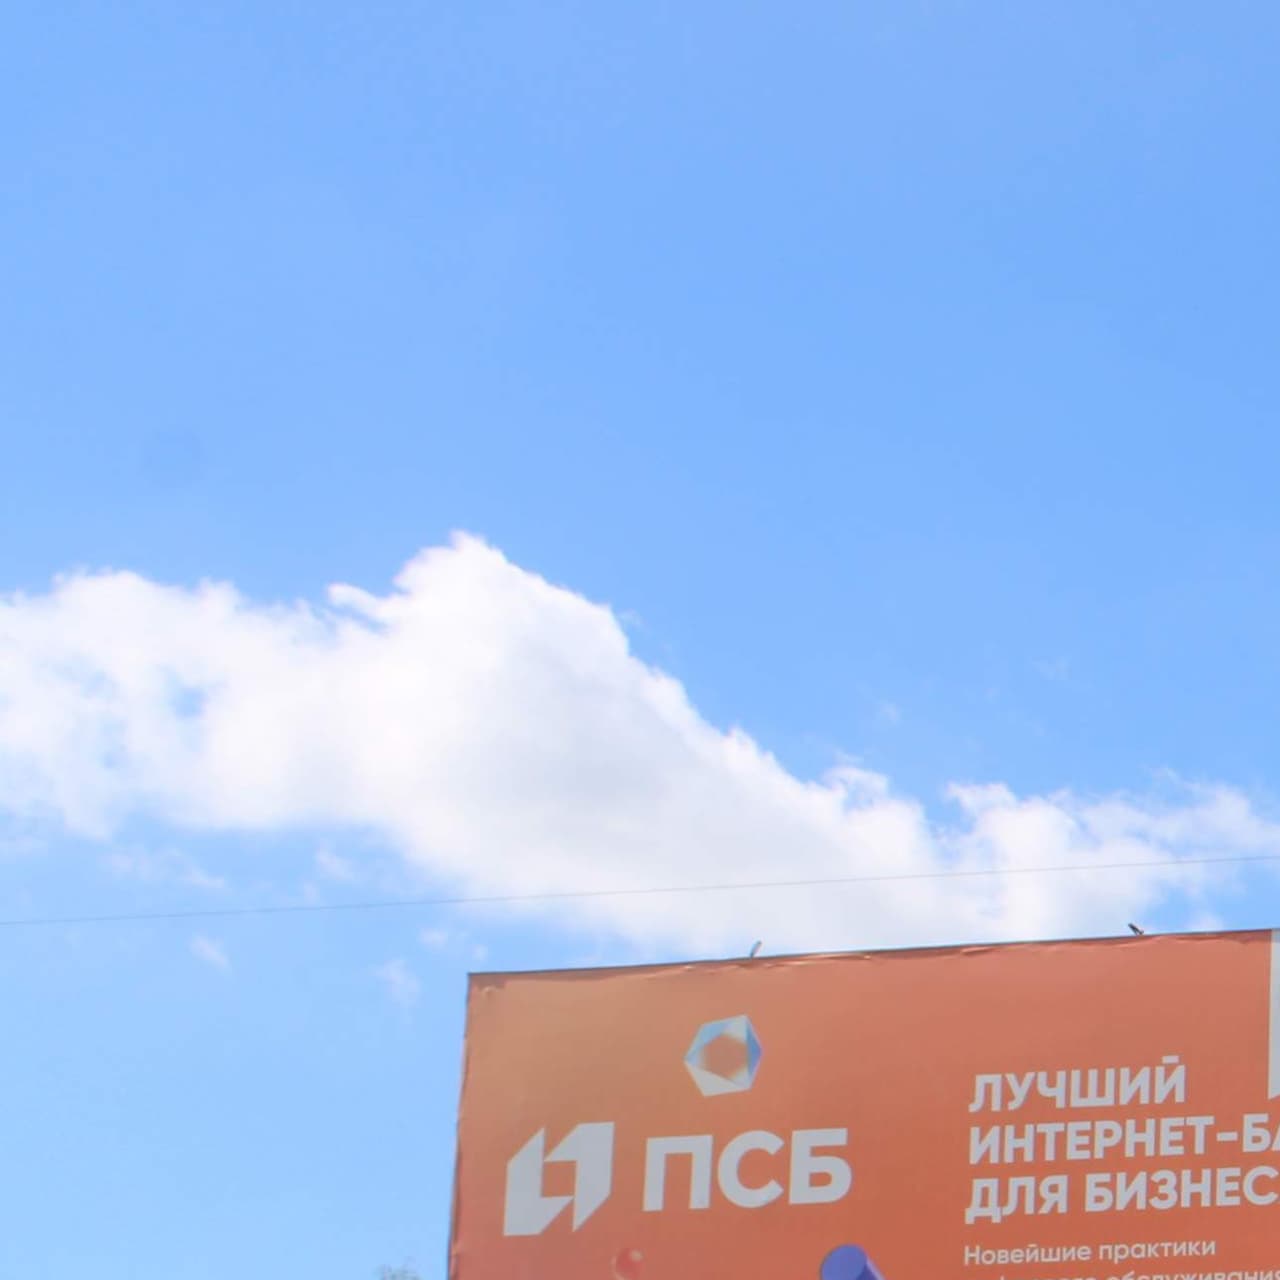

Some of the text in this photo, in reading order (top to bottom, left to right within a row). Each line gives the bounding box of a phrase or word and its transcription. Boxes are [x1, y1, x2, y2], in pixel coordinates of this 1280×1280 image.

[968, 1055, 1186, 1113] ЛУЧШИЙ
[642, 1128, 852, 1211] ПСБ
[964, 1175, 1068, 1224] ДЛЯ
[963, 1240, 1216, 1266] Новейшие практики
